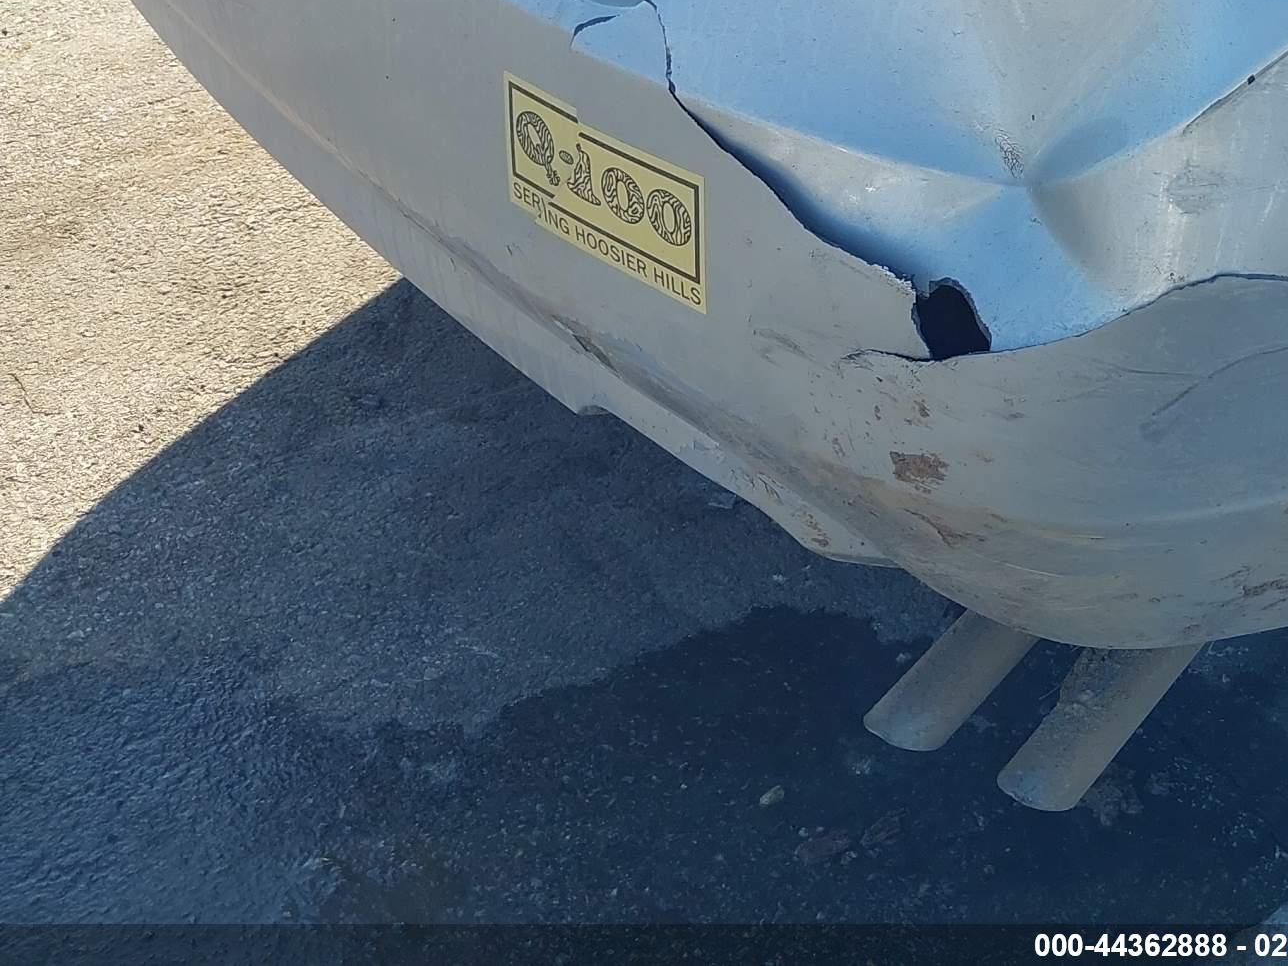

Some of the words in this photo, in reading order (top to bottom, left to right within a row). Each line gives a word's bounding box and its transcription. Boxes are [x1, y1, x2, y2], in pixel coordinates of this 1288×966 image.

[515, 110, 692, 247] Q-100
[574, 225, 648, 278] HOOSIER
[653, 266, 702, 306] HILLS
